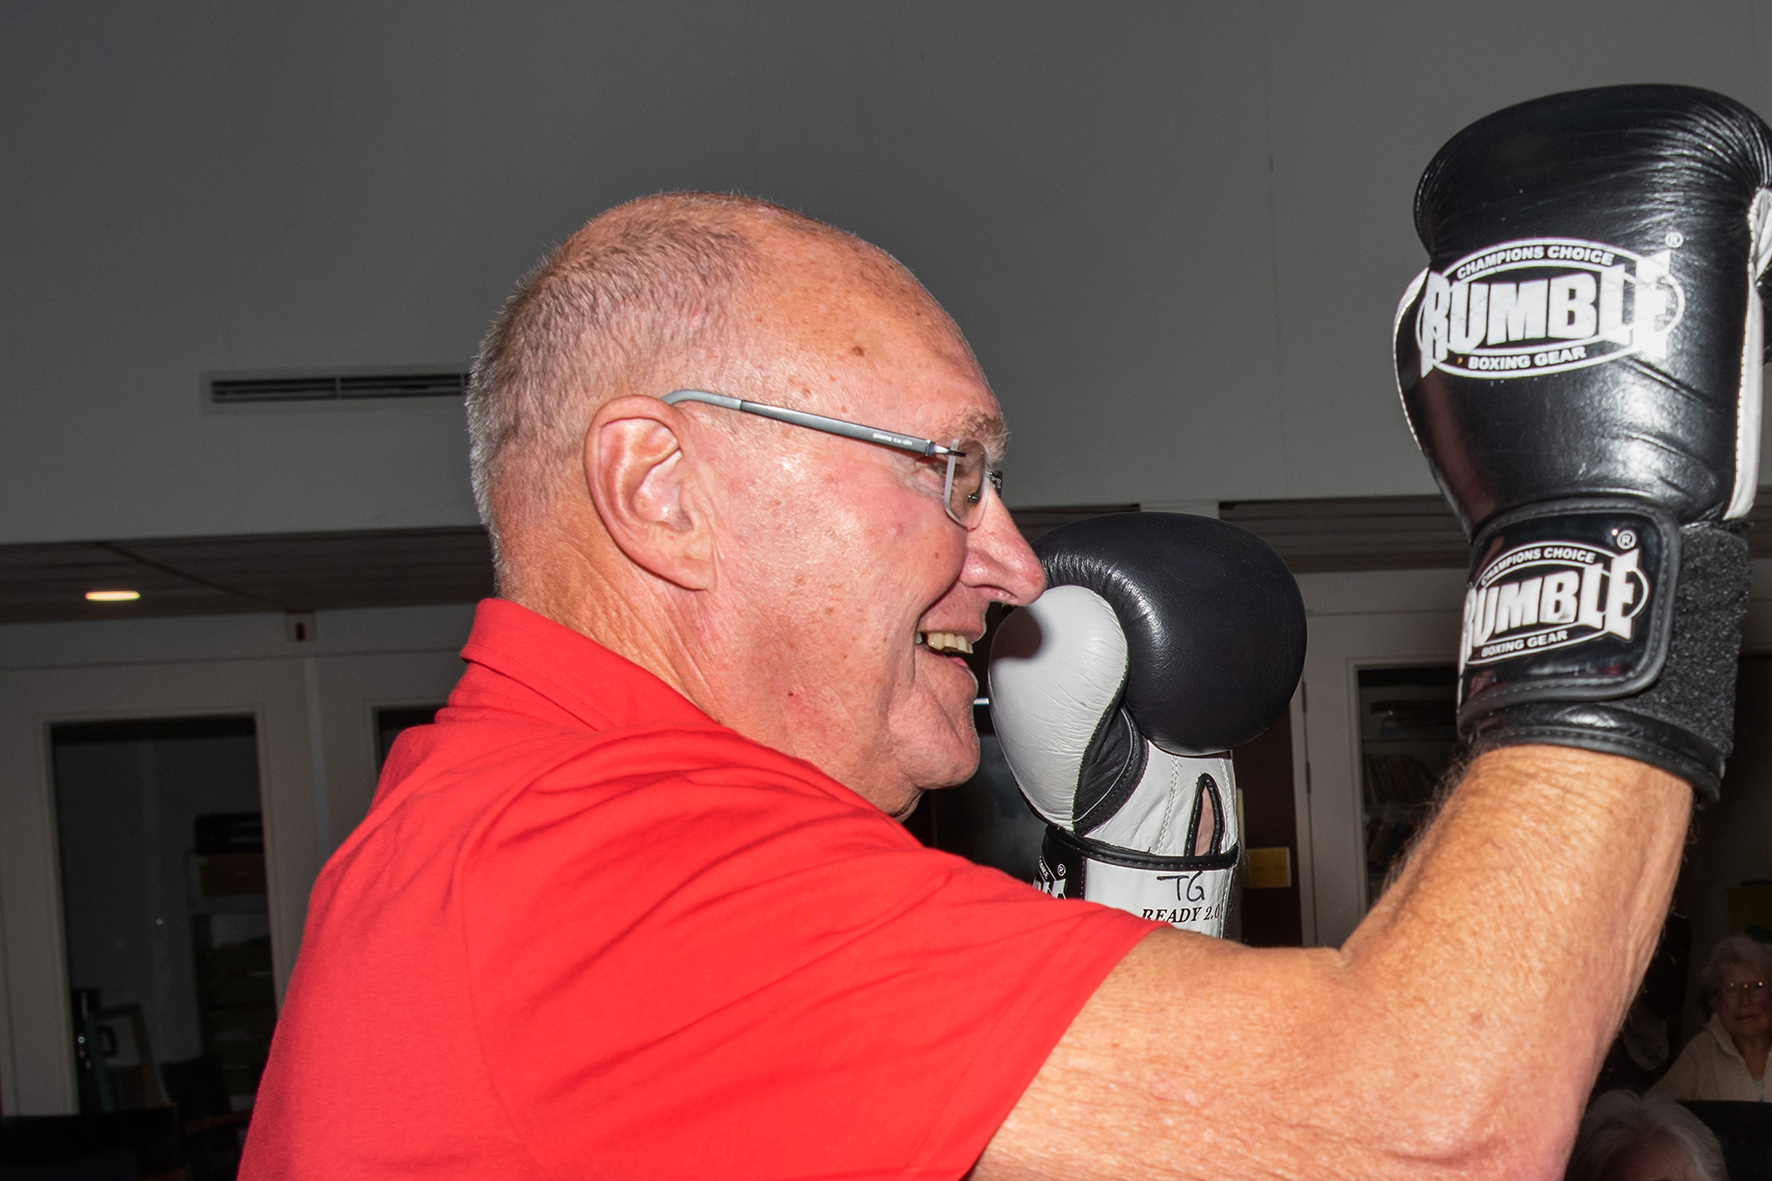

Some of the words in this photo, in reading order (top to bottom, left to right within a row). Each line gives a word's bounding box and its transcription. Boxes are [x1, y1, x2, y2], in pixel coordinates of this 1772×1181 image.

[1457, 245, 1545, 280] CHAMPIONS
[1547, 244, 1616, 266] CHOICE
[1420, 249, 1672, 379] RUMBLE
[1468, 351, 1531, 371] BOXING
[1533, 346, 1587, 367] GEAR
[1481, 548, 1541, 586] CHAMPIONS
[1543, 547, 1596, 564] CHOICE
[1458, 548, 1640, 677] RUMBLE
[1481, 639, 1525, 658] BOXING
[1526, 630, 1568, 648] GEAR
[1156, 870, 1205, 903] TG
[1142, 907, 1202, 923] READY
